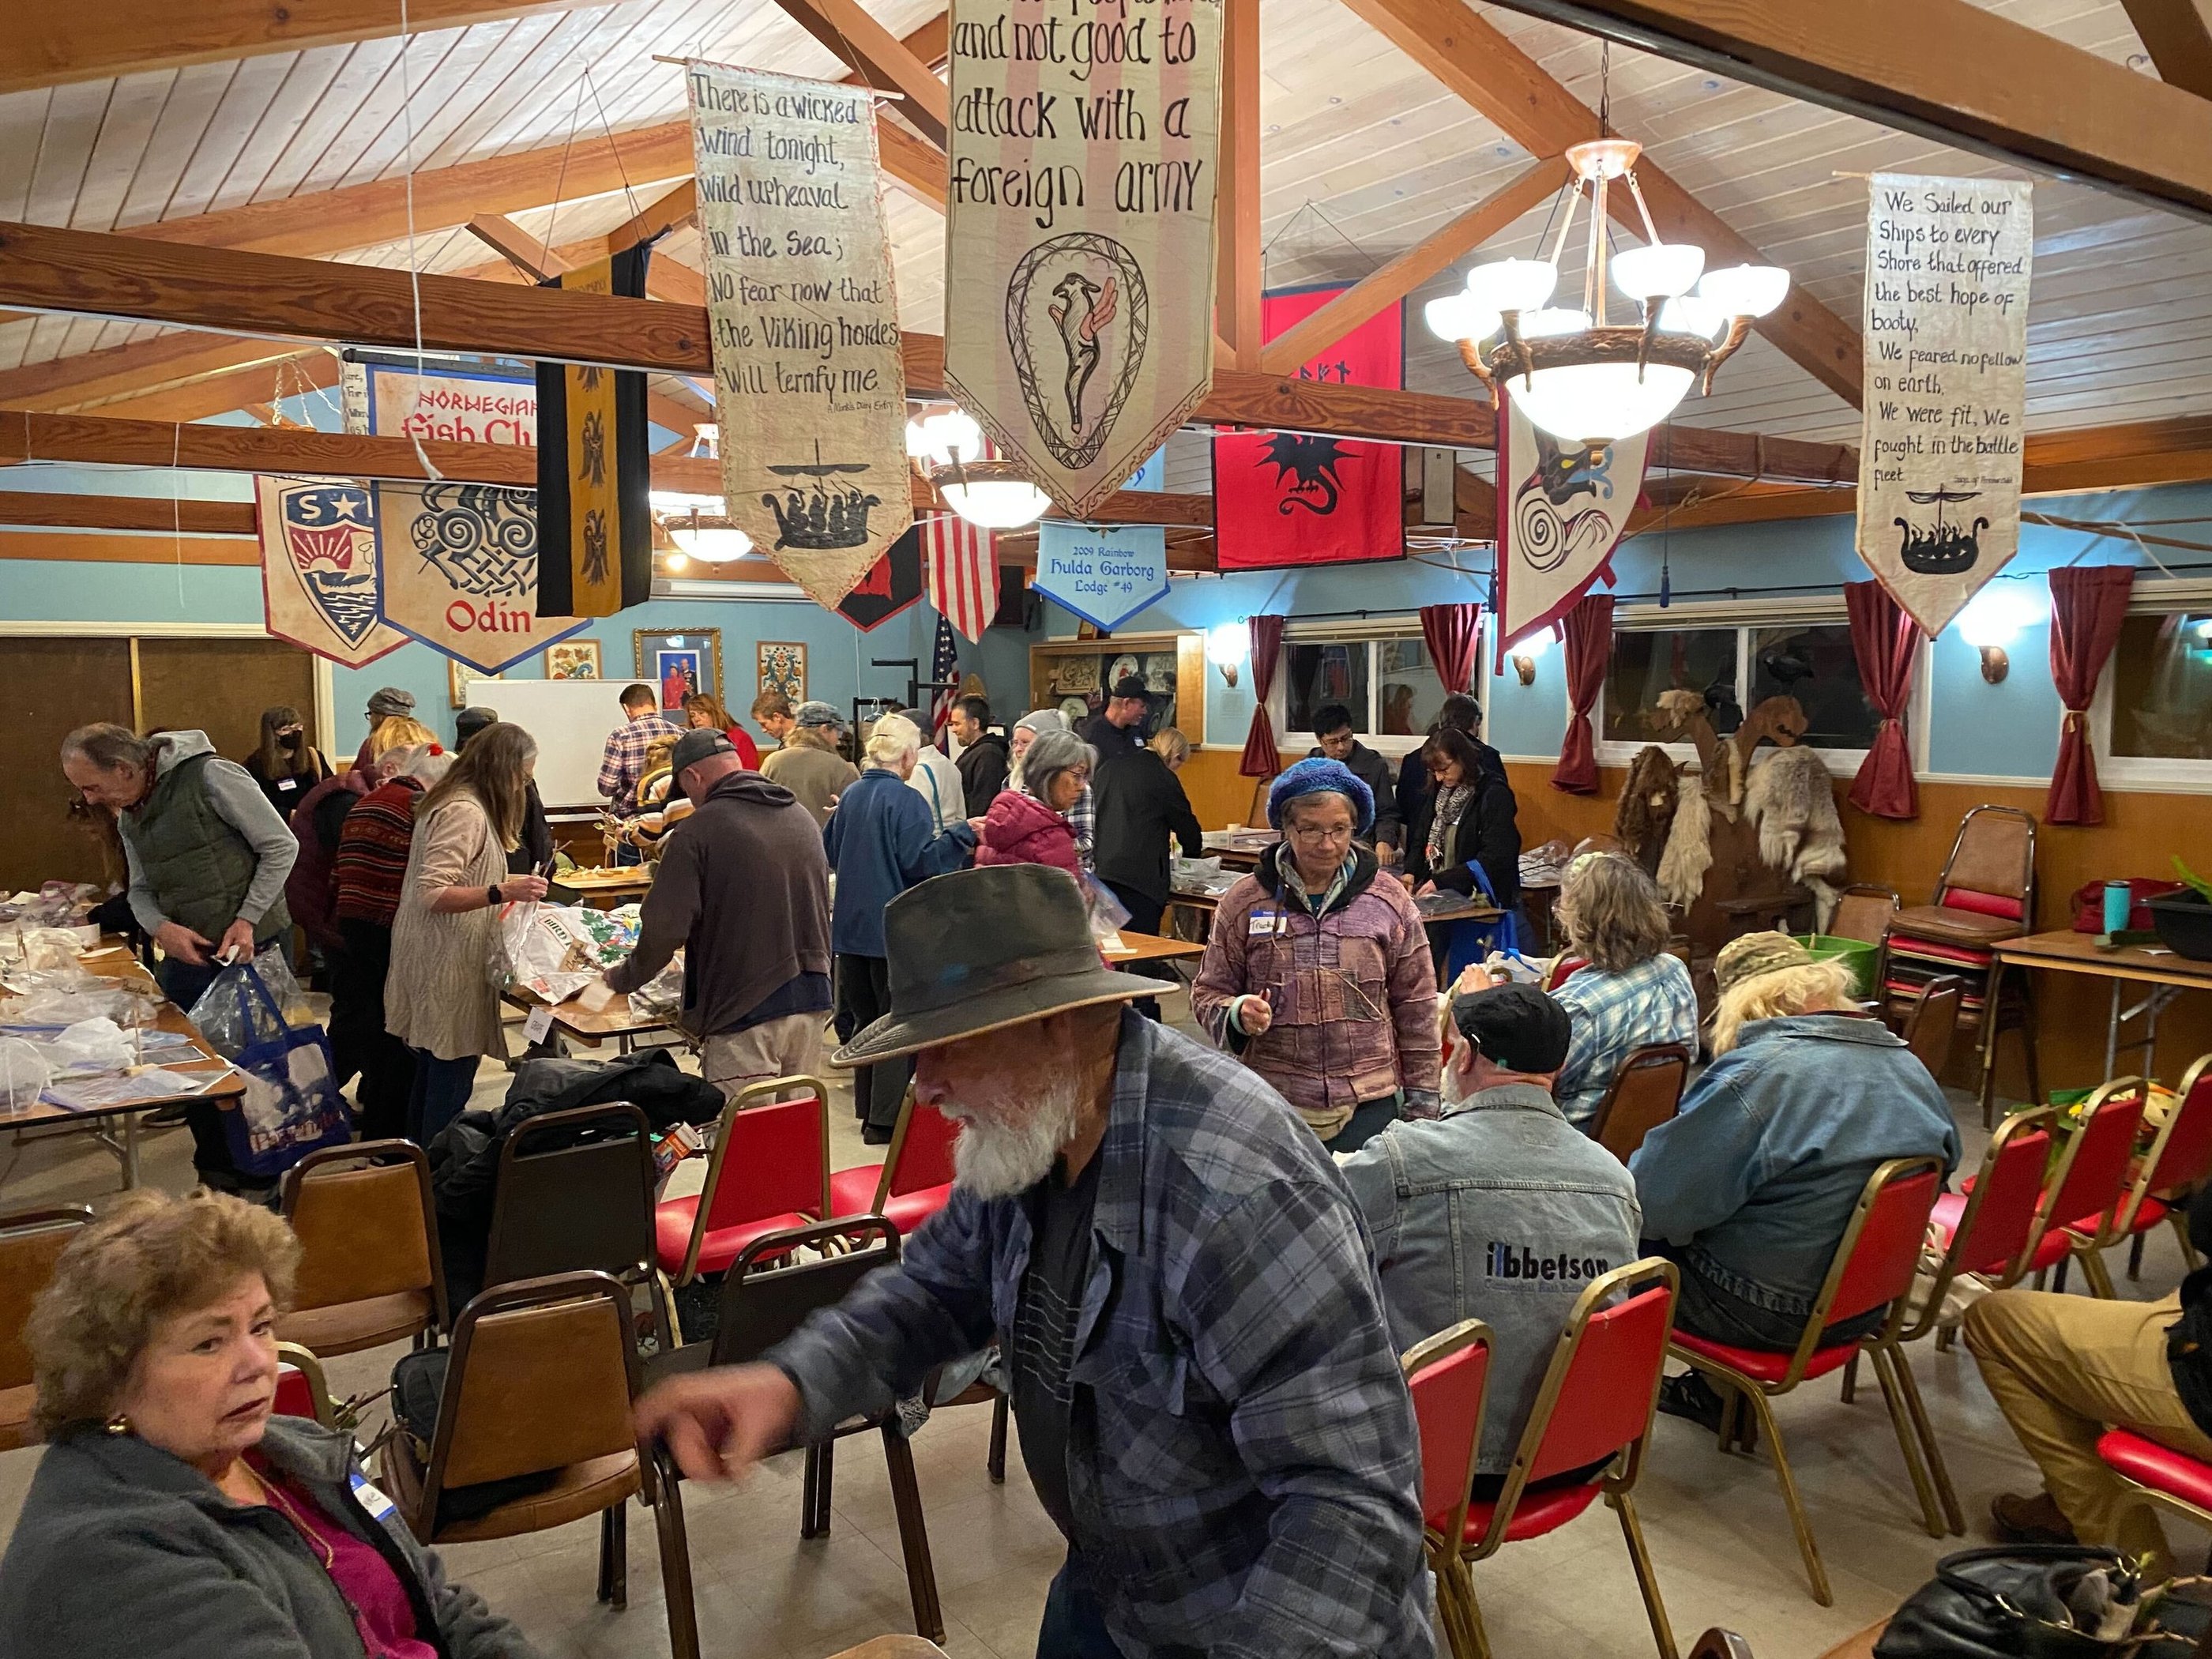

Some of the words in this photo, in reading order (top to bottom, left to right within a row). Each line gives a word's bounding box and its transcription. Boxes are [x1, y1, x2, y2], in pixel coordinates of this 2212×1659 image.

[954, 14, 1010, 60] and
[1014, 17, 1066, 64] not
[1069, 17, 1152, 81] good
[1158, 16, 1196, 65] to
[690, 73, 749, 112] There
[754, 88, 769, 115] is
[776, 96, 791, 118] a
[792, 92, 859, 124] wicked
[954, 87, 1057, 139] attack
[1075, 88, 1146, 141] with
[1164, 96, 1192, 139] a
[766, 130, 845, 175] tonight,
[748, 176, 848, 209] upheaval
[950, 157, 1084, 229] foreign
[1115, 159, 1203, 213] army
[1885, 190, 1914, 212] We
[1924, 190, 1974, 215] Sailed
[1981, 200, 2012, 215] our
[709, 227, 730, 255] in
[737, 226, 777, 258] the
[1879, 220, 1925, 254] Ships
[1929, 224, 1949, 243] to
[1954, 227, 2000, 255] every
[1878, 249, 1921, 270] Shore
[1927, 250, 1966, 273] that
[1967, 256, 2024, 282] offered
[739, 276, 784, 306] fear
[791, 279, 833, 303] now
[837, 277, 884, 303] that
[1875, 281, 1901, 302] the
[1907, 280, 1942, 304] best
[1951, 282, 1990, 315] hope
[1994, 293, 2014, 315] of
[717, 318, 754, 348] the
[760, 316, 833, 359] Viking
[838, 316, 899, 346] hordes
[1872, 308, 1919, 341] booty,
[1879, 340, 1902, 360] We
[1909, 349, 1958, 373] feared
[1960, 353, 1979, 365] no
[1981, 352, 2023, 374] fellow
[775, 361, 837, 404] terrify
[1874, 376, 1891, 390] on
[874, 400, 894, 417] Entry
[1879, 401, 1898, 421] We
[1906, 407, 1943, 423] were
[1951, 404, 1977, 427] fit,
[1874, 435, 1924, 463] fought
[1932, 436, 1946, 454] in
[1951, 435, 1973, 453] the
[1976, 435, 2018, 454] battle
[1874, 468, 1904, 491] fleet
[1073, 546, 1094, 556] 2009
[1098, 547, 1134, 558] Rainbow
[1051, 559, 1093, 574] Hulda
[1100, 560, 1154, 581] Garborg
[1075, 580, 1108, 595] Lodge
[446, 599, 531, 634] Odin
